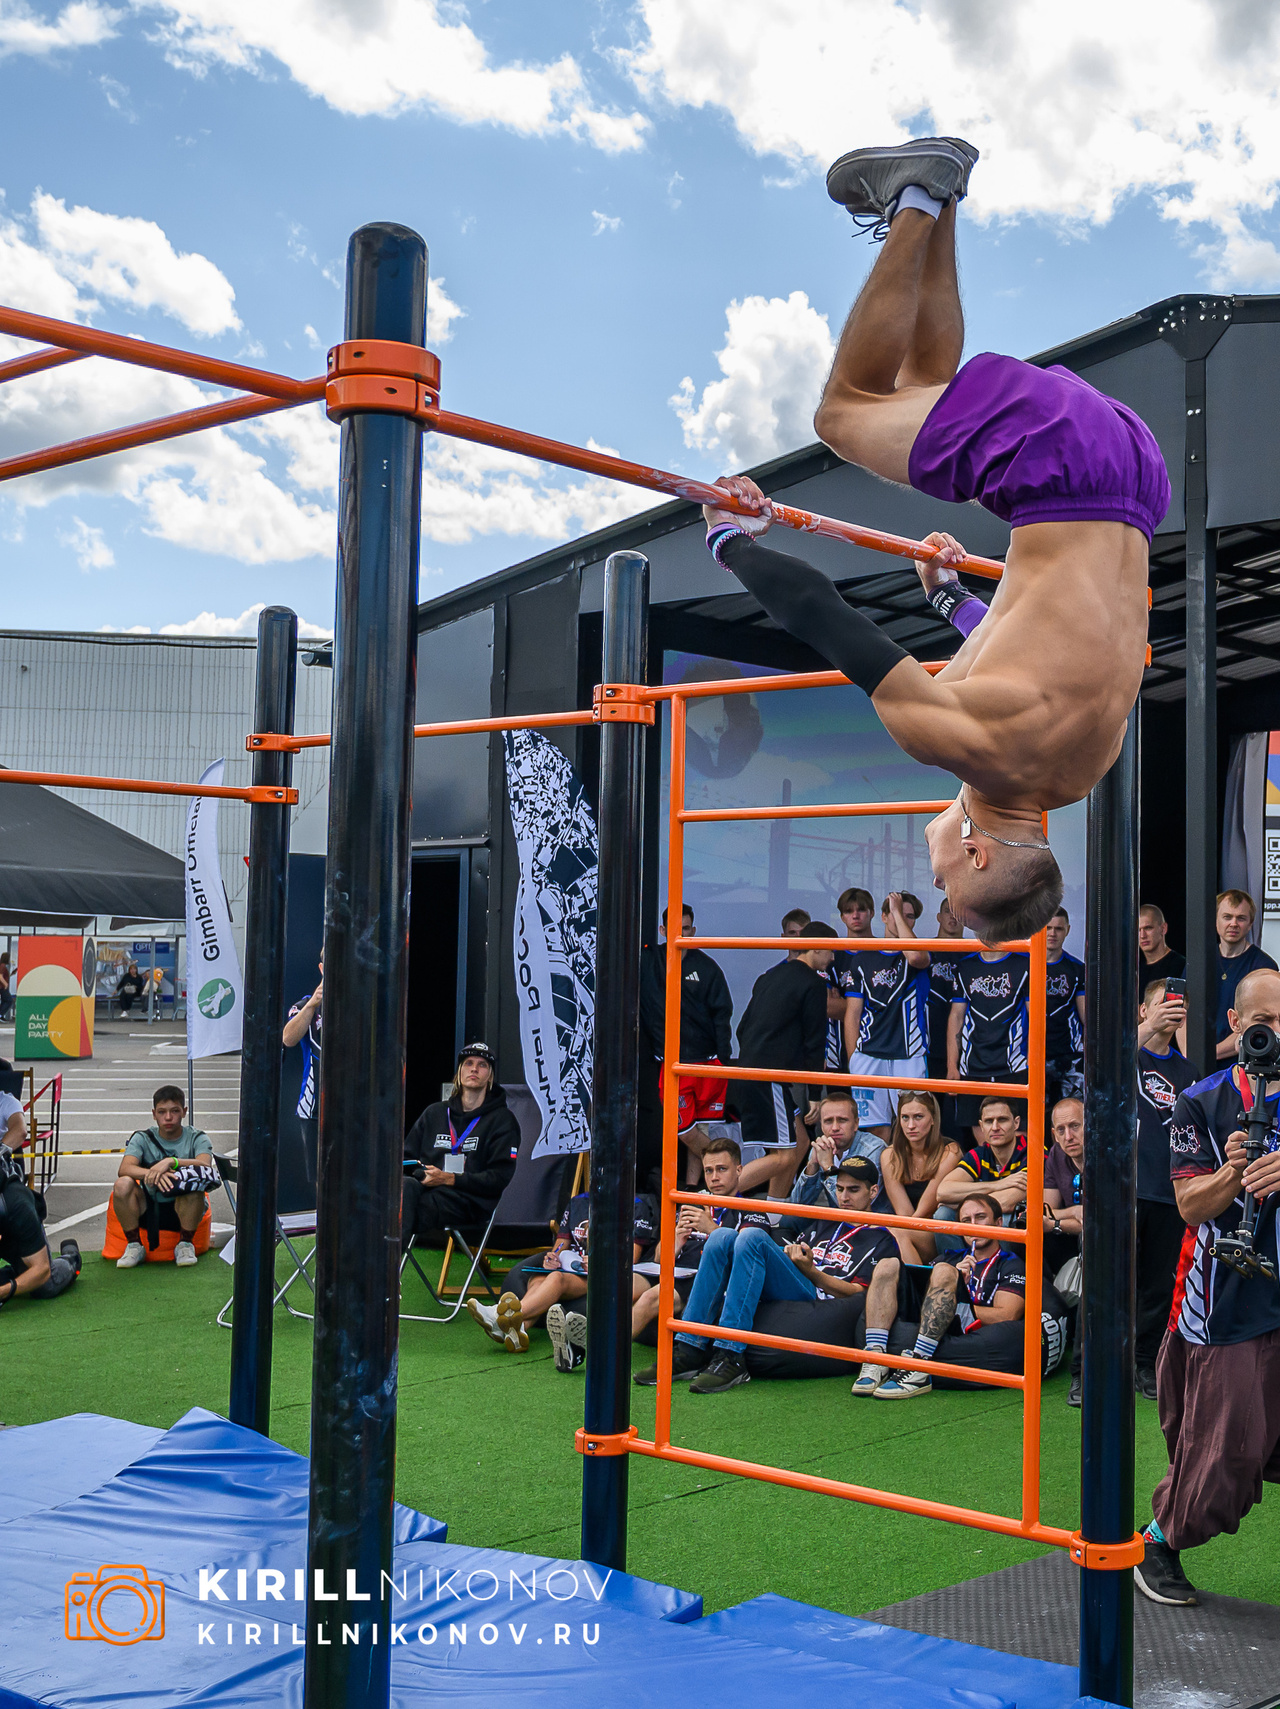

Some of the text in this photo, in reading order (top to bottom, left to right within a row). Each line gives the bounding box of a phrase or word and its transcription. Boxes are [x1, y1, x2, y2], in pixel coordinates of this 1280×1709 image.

[190, 877, 221, 962] Gimbarr
[29, 1013, 49, 1021] ALL
[28, 1022, 48, 1030] DAY
[28, 1030, 64, 1038] PARTY
